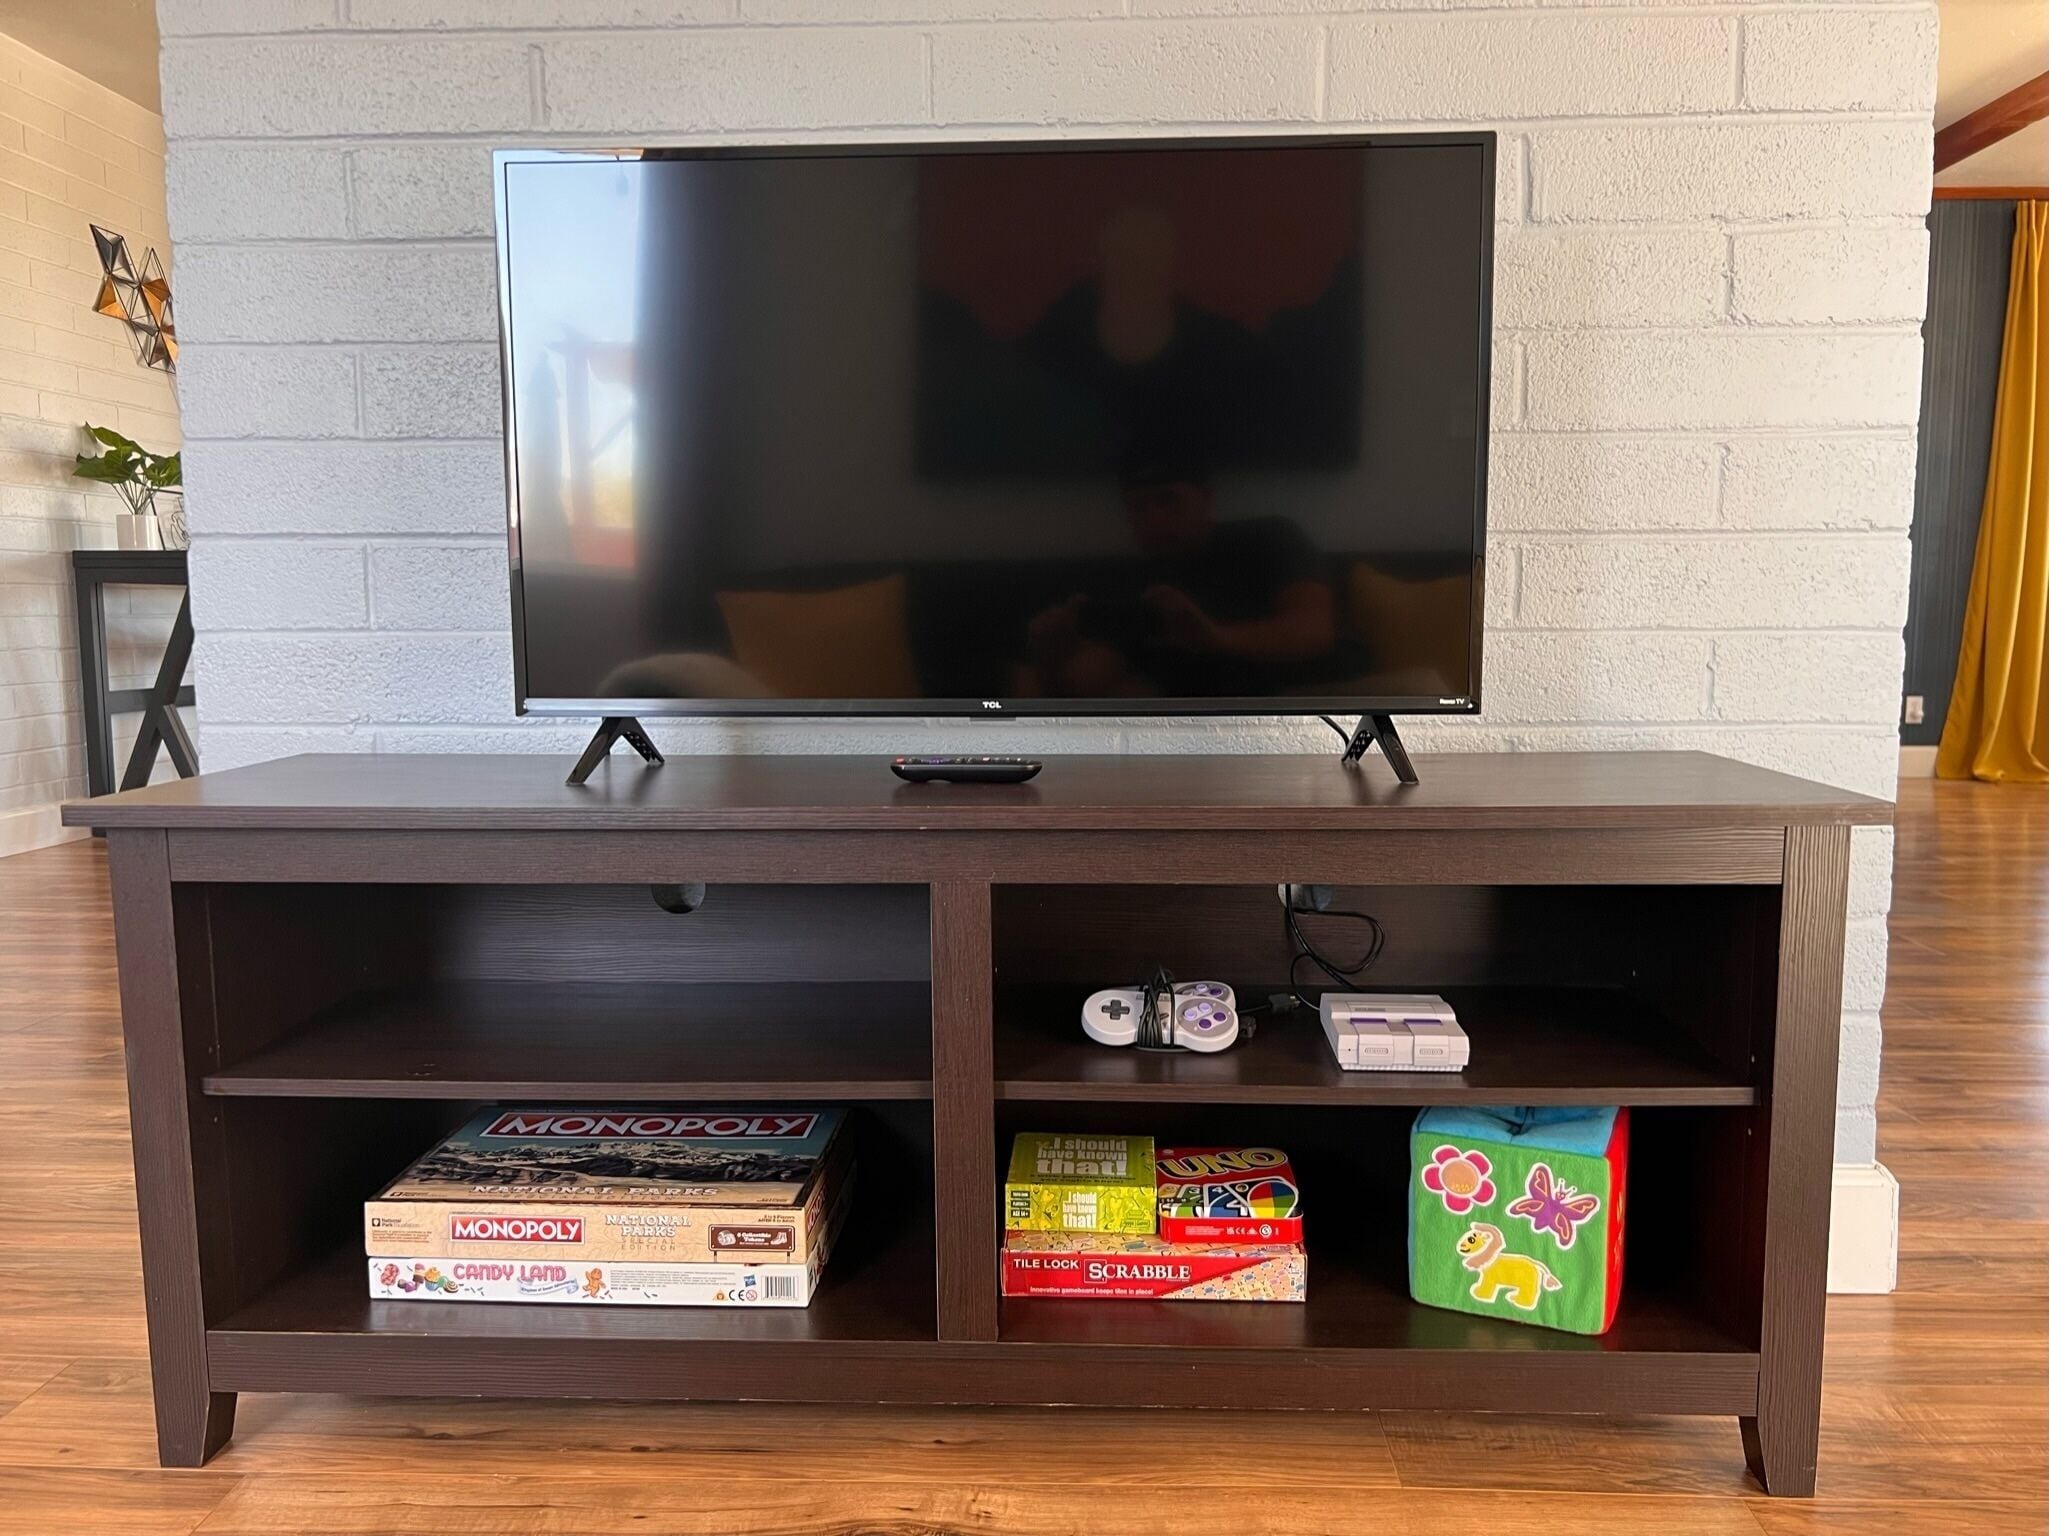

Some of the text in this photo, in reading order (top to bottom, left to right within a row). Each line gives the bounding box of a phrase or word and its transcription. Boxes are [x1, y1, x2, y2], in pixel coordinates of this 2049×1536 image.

[982, 701, 1002, 709] TCL
[502, 1116, 806, 1135] MONOPOLY
[1064, 1138, 1127, 1151] should
[1037, 1148, 1127, 1160] have known
[1036, 1158, 1127, 1176] that!
[1157, 1149, 1288, 1179] UNO
[472, 1185, 719, 1196] NATIONAL PARKS
[1073, 1192, 1097, 1204] should
[605, 1214, 692, 1227] NATIONAL
[1063, 1212, 1097, 1229] that!
[455, 1219, 580, 1240] MONOPOLY
[621, 1225, 676, 1237] PARKS
[1013, 1259, 1080, 1269] TILE LOCK
[453, 1263, 567, 1282] CANDY LAND
[1089, 1263, 1191, 1281] SCRABBLE
[1030, 1286, 1061, 1294] Innovative
[1061, 1287, 1095, 1296] gameboard
[1096, 1287, 1114, 1296] keeps
